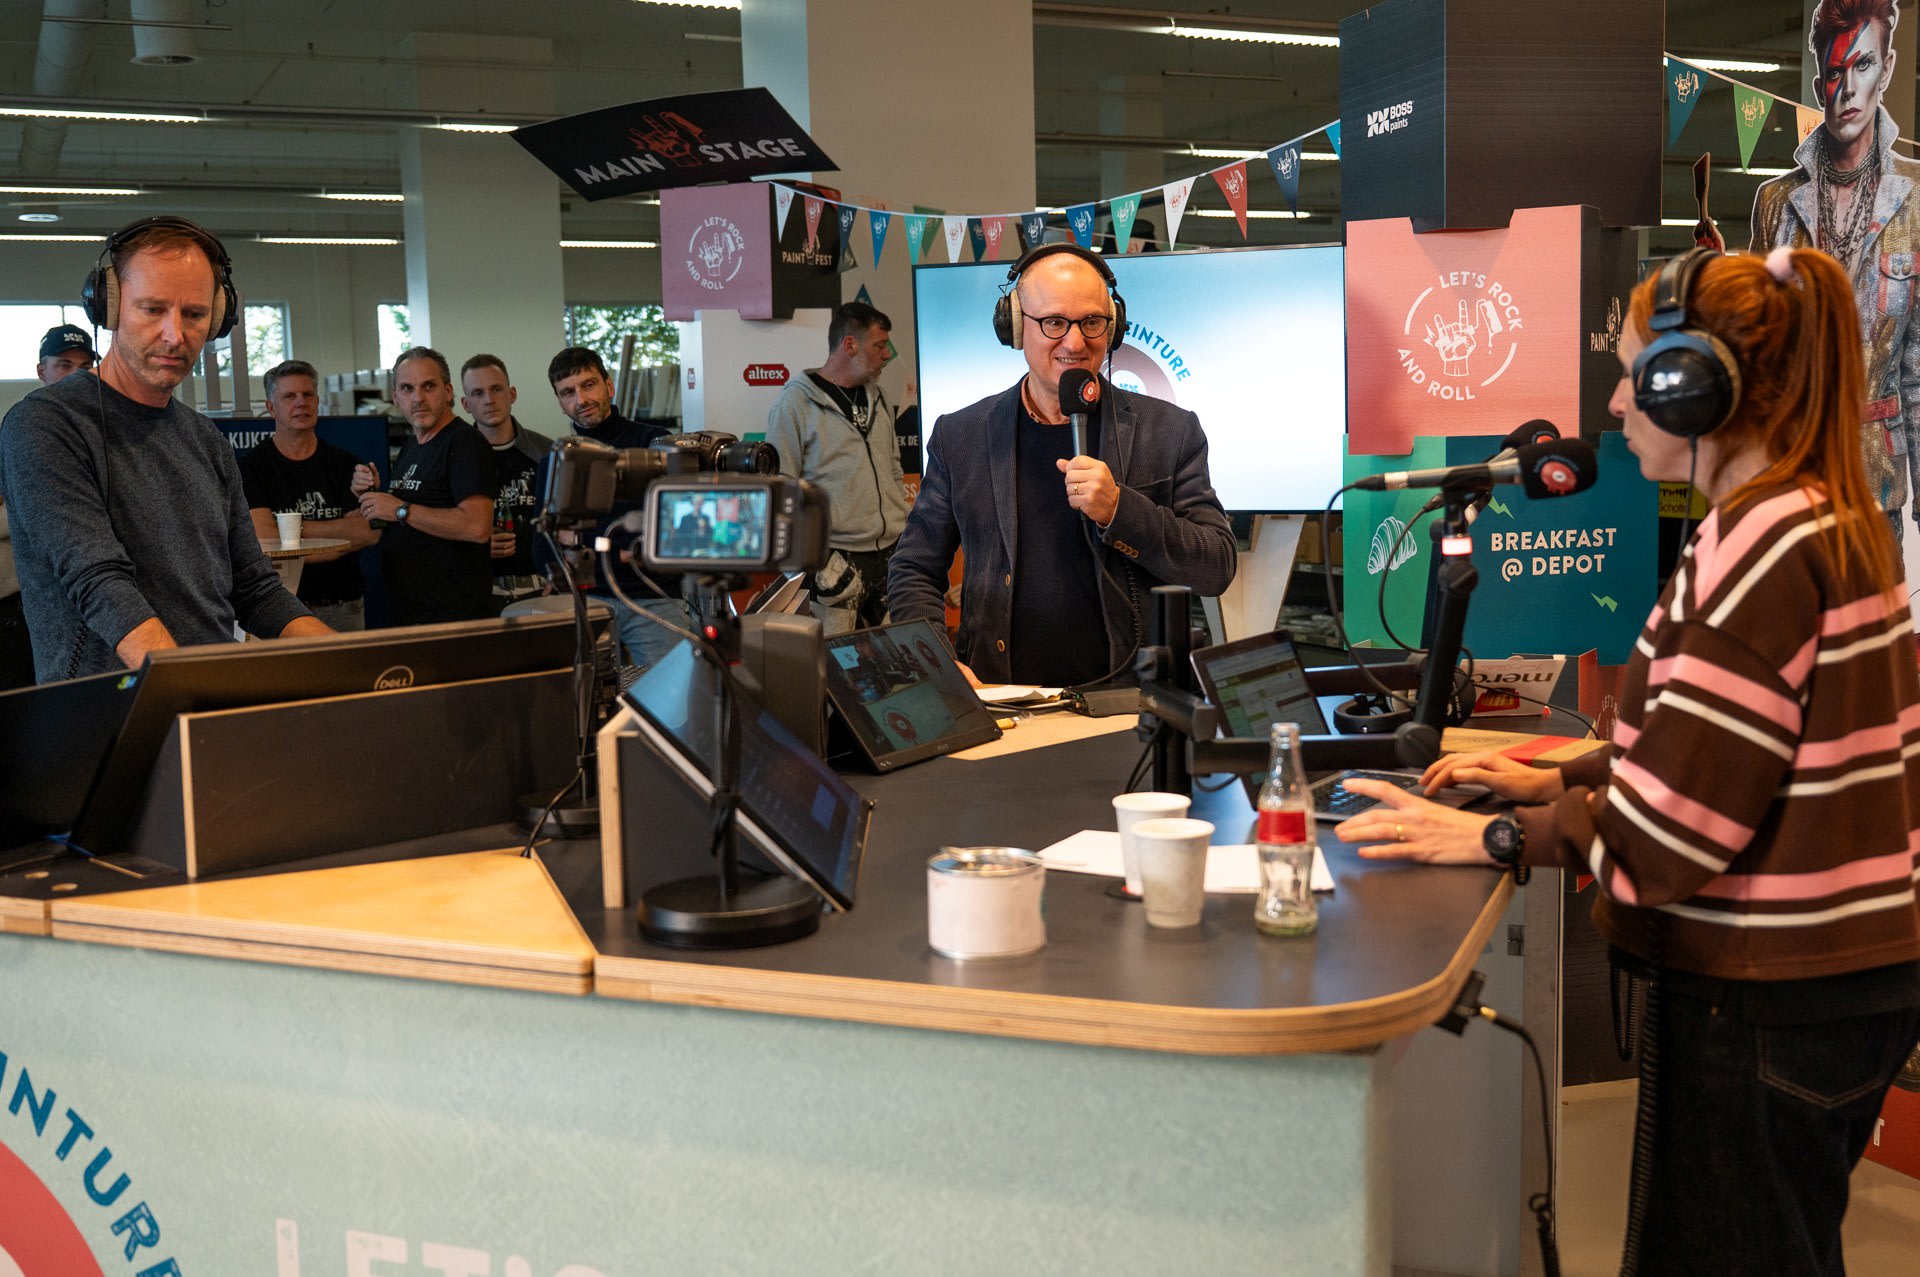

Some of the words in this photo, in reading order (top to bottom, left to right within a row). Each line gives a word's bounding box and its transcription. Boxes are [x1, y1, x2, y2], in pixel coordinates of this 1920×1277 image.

[1390, 100, 1413, 120] BOSS
[1390, 117, 1409, 134] paints
[574, 153, 666, 185] MAIN
[698, 138, 807, 163] STAGE
[704, 216, 728, 228] LET'S
[727, 222, 745, 251] ROCK
[782, 251, 806, 264] PAINT
[815, 254, 833, 266] FEST
[686, 260, 701, 281] AND
[700, 279, 725, 290] ROLL
[1439, 271, 1487, 289] LET'S
[1487, 281, 1523, 332] ROCK
[1590, 332, 1609, 352] PAINT
[748, 366, 784, 380] altrex
[1397, 348, 1426, 384] AND
[1427, 379, 1476, 401] ROLL
[1491, 527, 1617, 552] BREAKFAST
[1501, 557, 1523, 582] @
[1532, 554, 1606, 576] DEPOT
